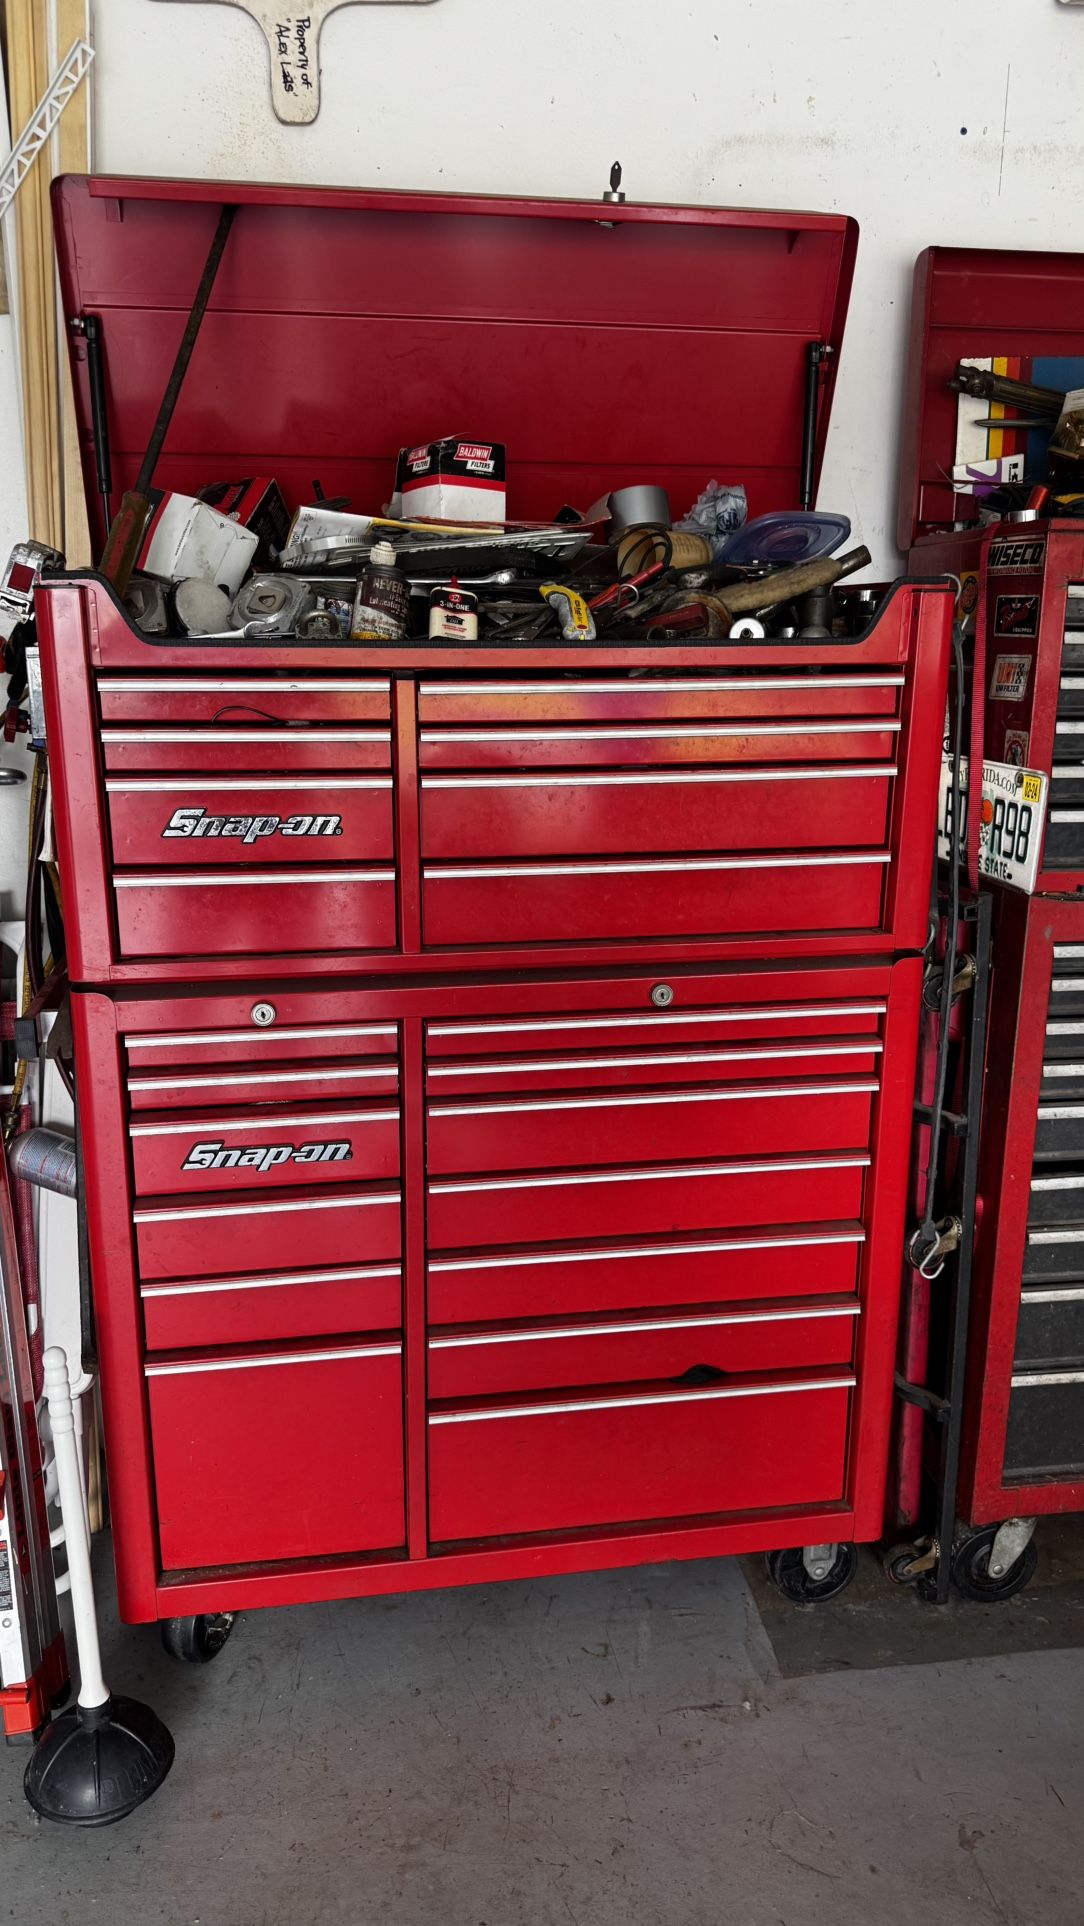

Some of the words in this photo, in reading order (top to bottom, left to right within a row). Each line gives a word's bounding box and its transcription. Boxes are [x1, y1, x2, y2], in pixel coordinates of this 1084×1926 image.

[301, 73, 313, 90] of
[458, 446, 489, 459] BALDWIN
[470, 461, 491, 469] FILTERS
[439, 600, 470, 612] 3-IN-ONE
[1024, 780, 1039, 800] 02-24
[162, 807, 342, 844] Snap-on
[990, 797, 1033, 865] R98
[985, 857, 1008, 880] STATE
[180, 1139, 352, 1172] Snap-on
